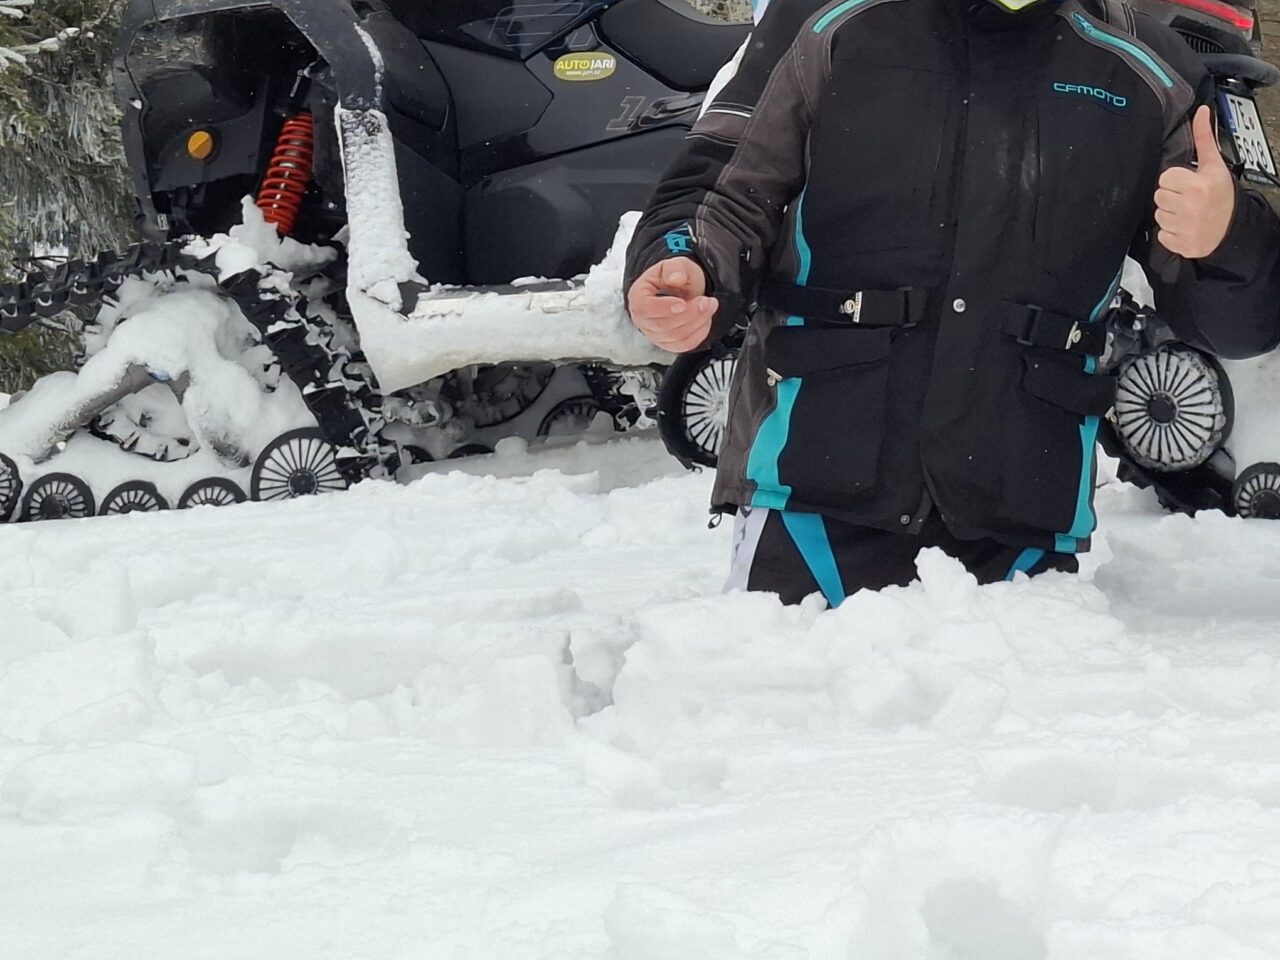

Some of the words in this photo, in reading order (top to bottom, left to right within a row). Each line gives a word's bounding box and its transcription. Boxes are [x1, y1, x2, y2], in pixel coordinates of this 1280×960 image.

[1053, 82, 1127, 107] CFMOTO
[1230, 98, 1251, 131] 7E
[1235, 134, 1269, 168] 5618
